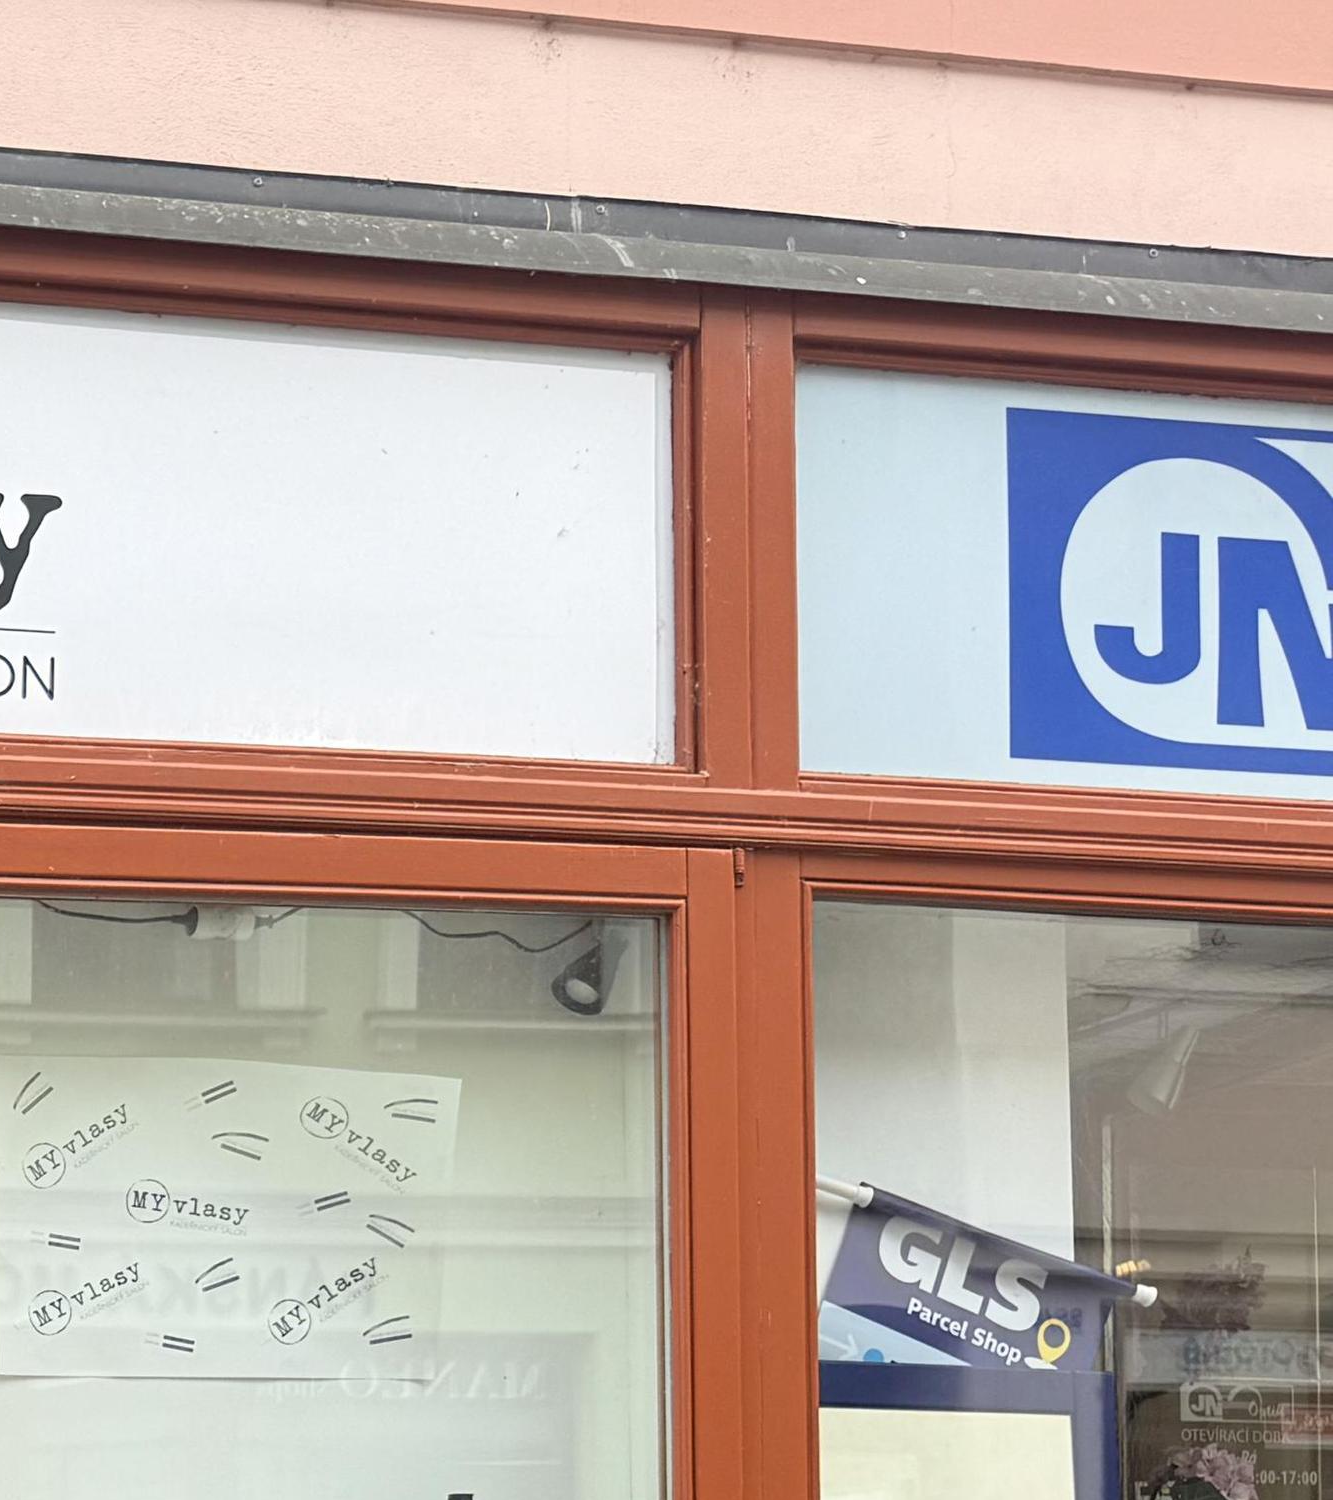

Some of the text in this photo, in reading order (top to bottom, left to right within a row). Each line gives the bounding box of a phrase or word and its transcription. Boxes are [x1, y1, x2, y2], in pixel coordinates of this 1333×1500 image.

[63, 1104, 129, 1154] vlasy
[347, 1130, 417, 1182] vlasy
[173, 1198, 249, 1225] vlasy
[71, 1262, 140, 1305] vlasy
[308, 1257, 378, 1310] vlasy
[879, 1216, 1048, 1331] GLS
[907, 1297, 1021, 1366] Parcel Shop
